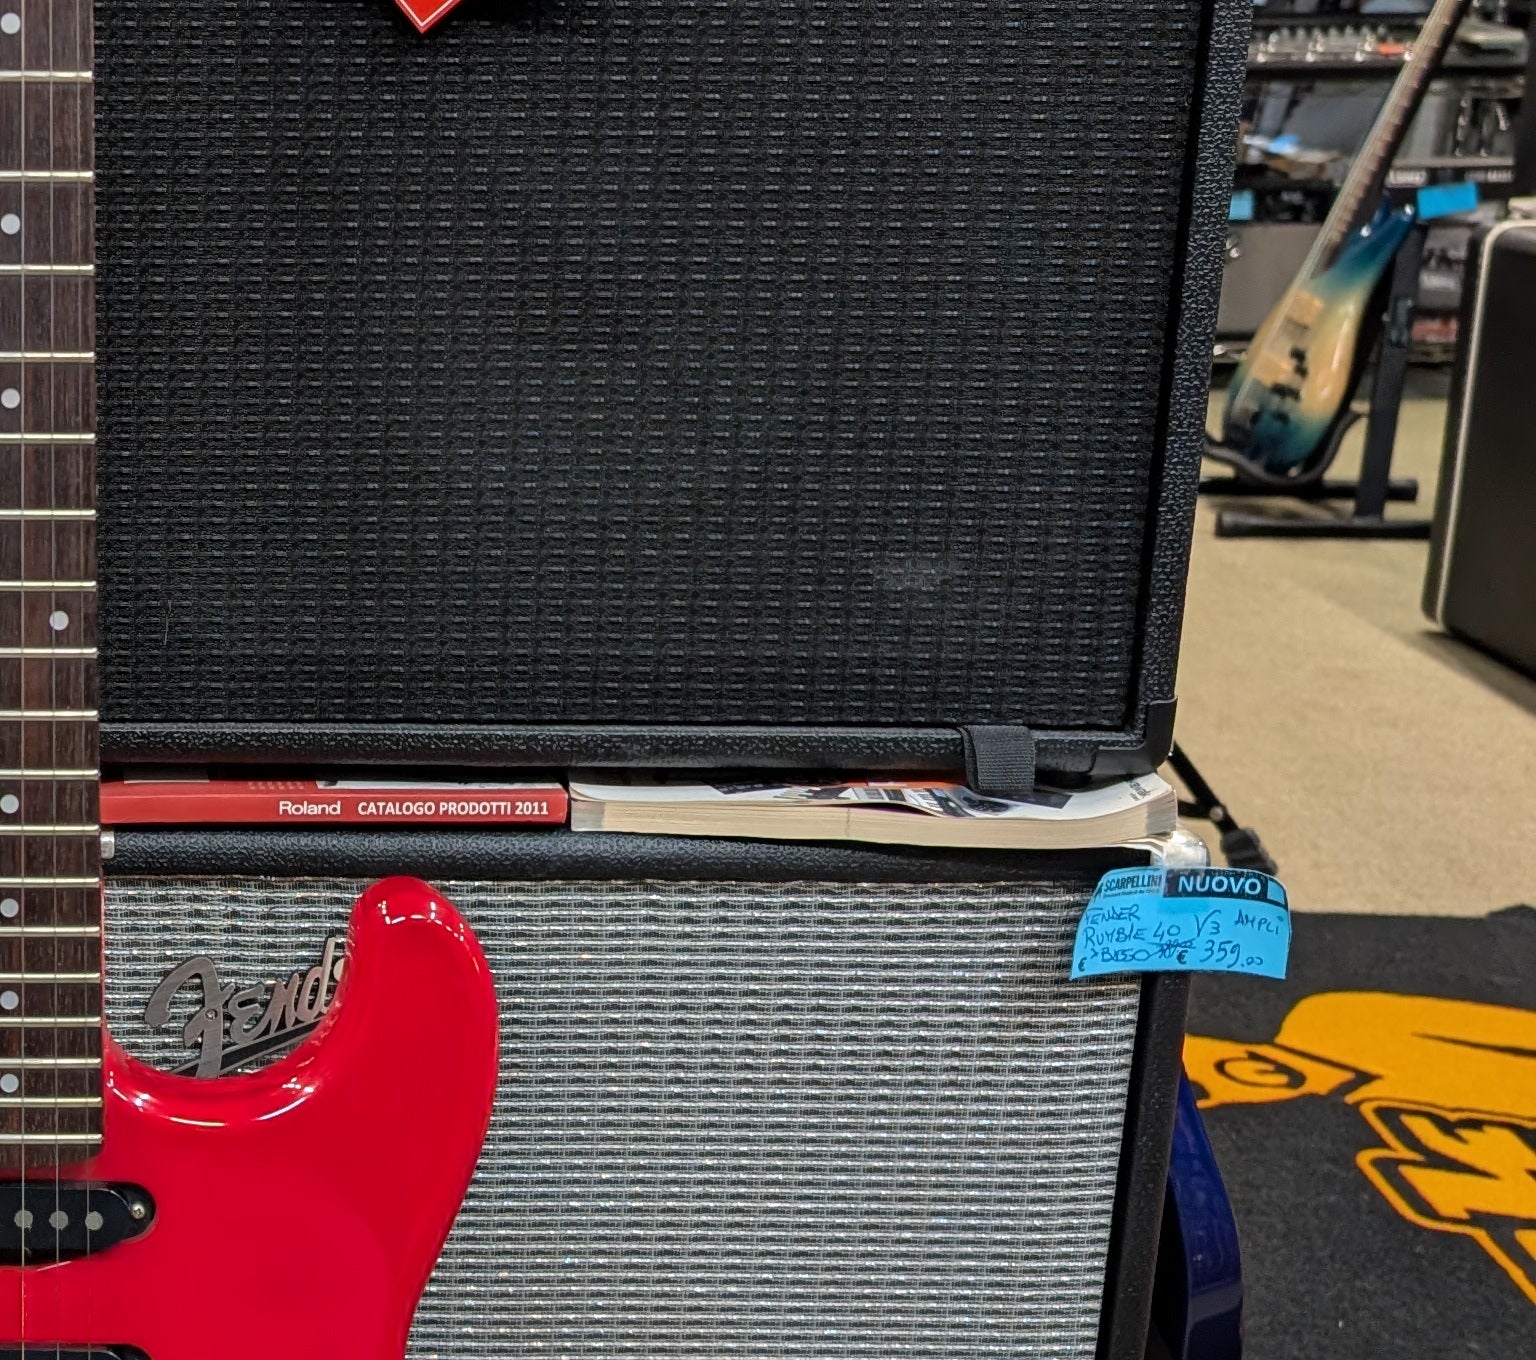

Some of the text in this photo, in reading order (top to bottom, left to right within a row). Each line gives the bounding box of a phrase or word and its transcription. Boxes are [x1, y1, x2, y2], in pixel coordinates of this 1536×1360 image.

[279, 800, 548, 817] Roland CATALOGO PRODOTTI 2011
[1104, 873, 1162, 892] SCARPELLINI
[1178, 875, 1263, 895] NUOVO
[1153, 921, 1181, 943] 40
[145, 937, 341, 1078] Fend
